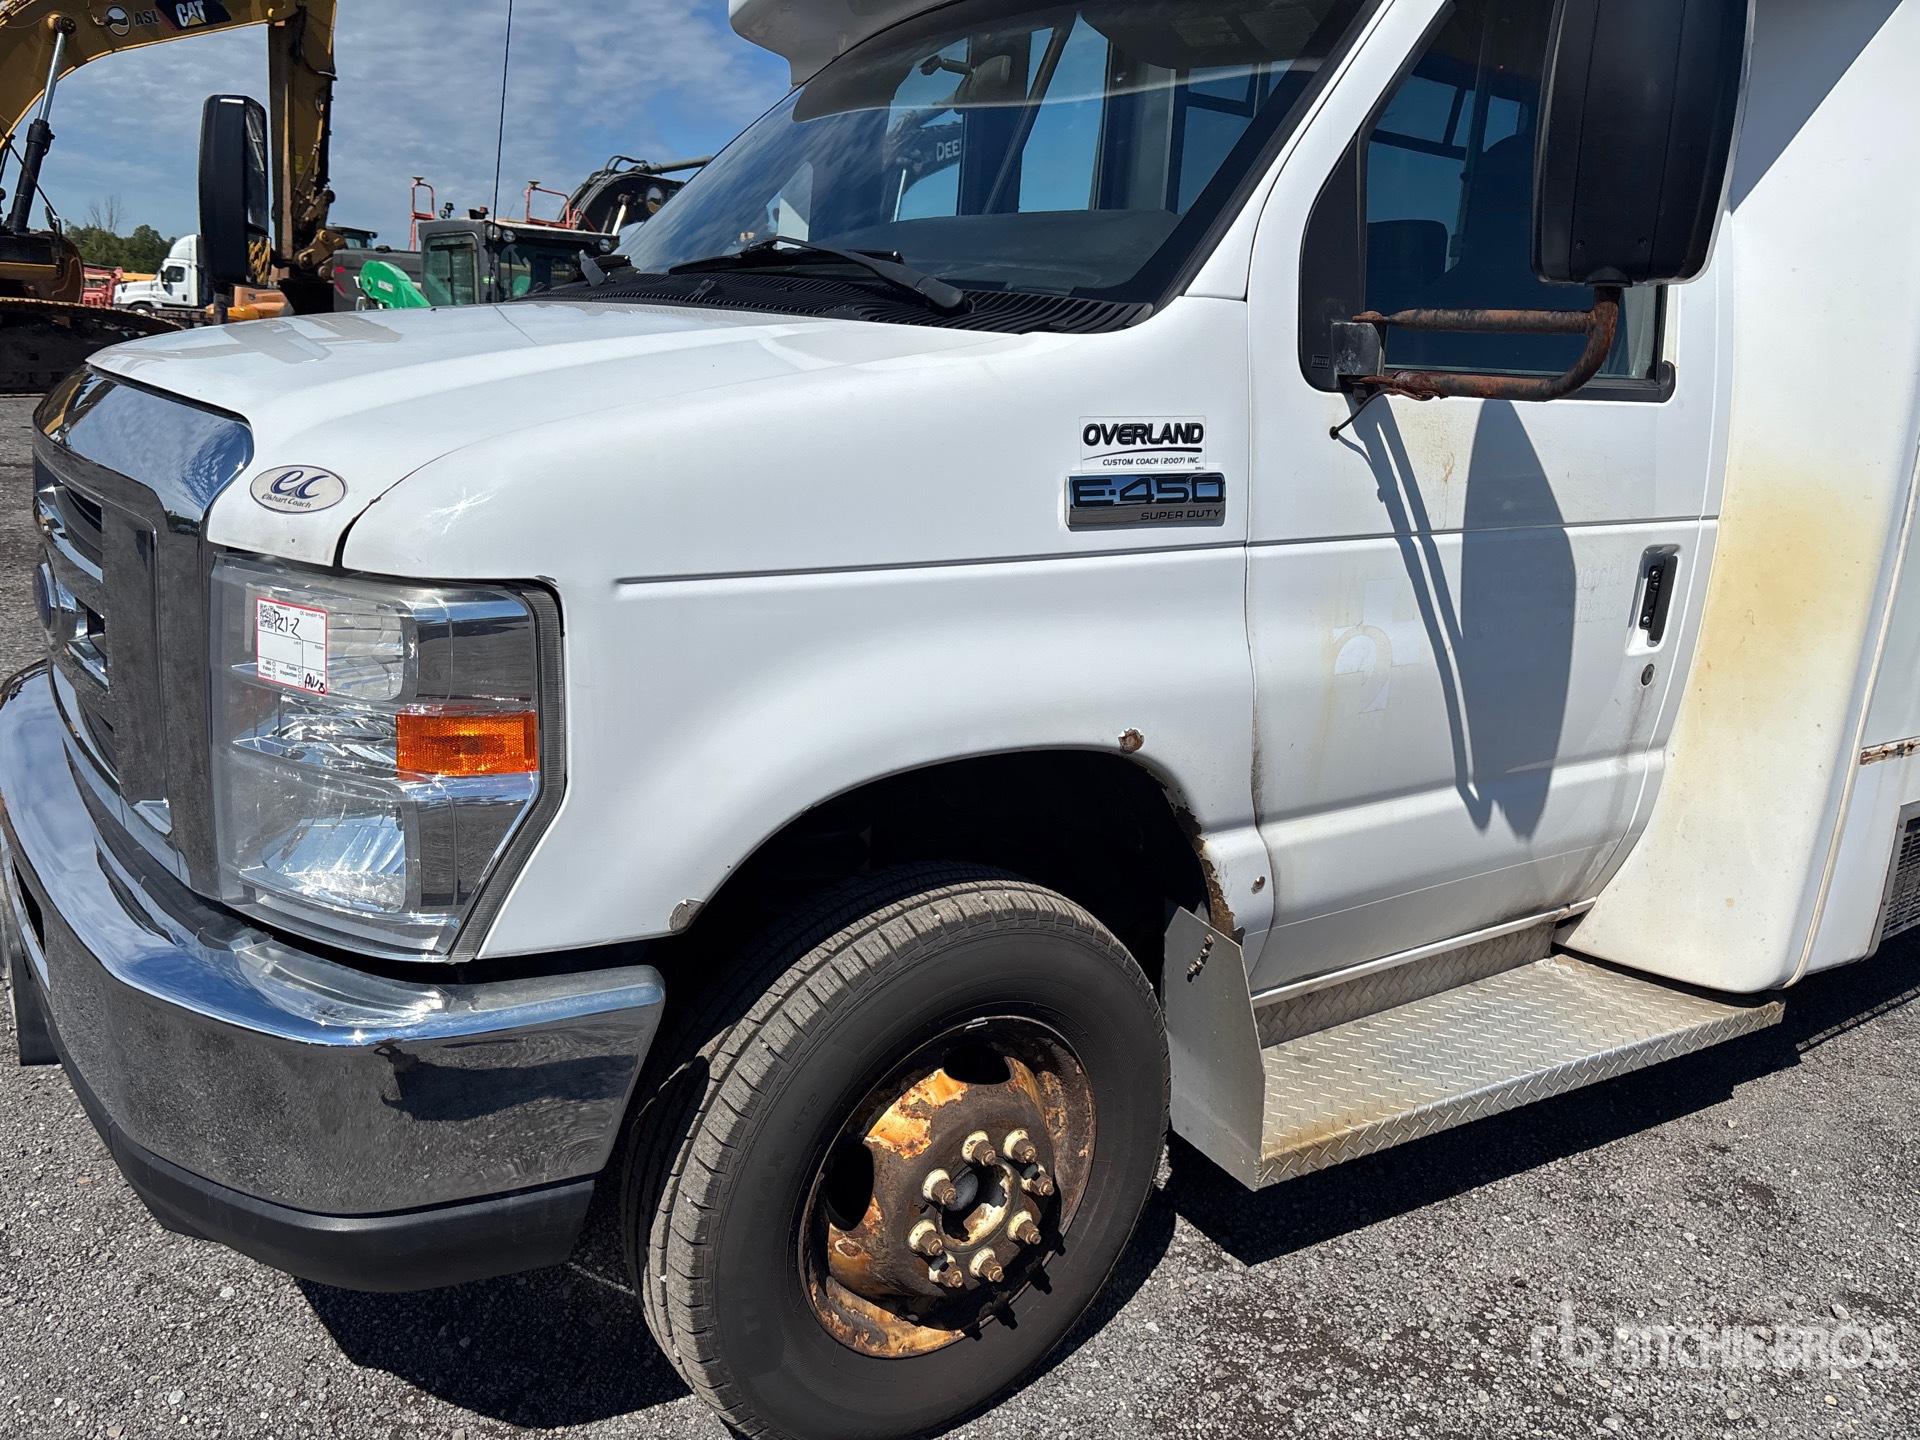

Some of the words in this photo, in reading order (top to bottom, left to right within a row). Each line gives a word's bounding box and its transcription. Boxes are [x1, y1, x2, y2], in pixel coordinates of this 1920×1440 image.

[134, 9, 160, 26] ASL
[175, 0, 207, 27] CAT
[1083, 422, 1204, 446] OVERLAND
[1102, 458, 1134, 466] CUSTOM
[1135, 457, 1159, 465] COACH
[1160, 456, 1186, 465] (2007)
[1187, 456, 1201, 464] INC.
[261, 493, 287, 503] Elkhart
[288, 498, 312, 509] Coach
[1140, 510, 1184, 521] SUPER
[1186, 509, 1222, 519] DUTY
